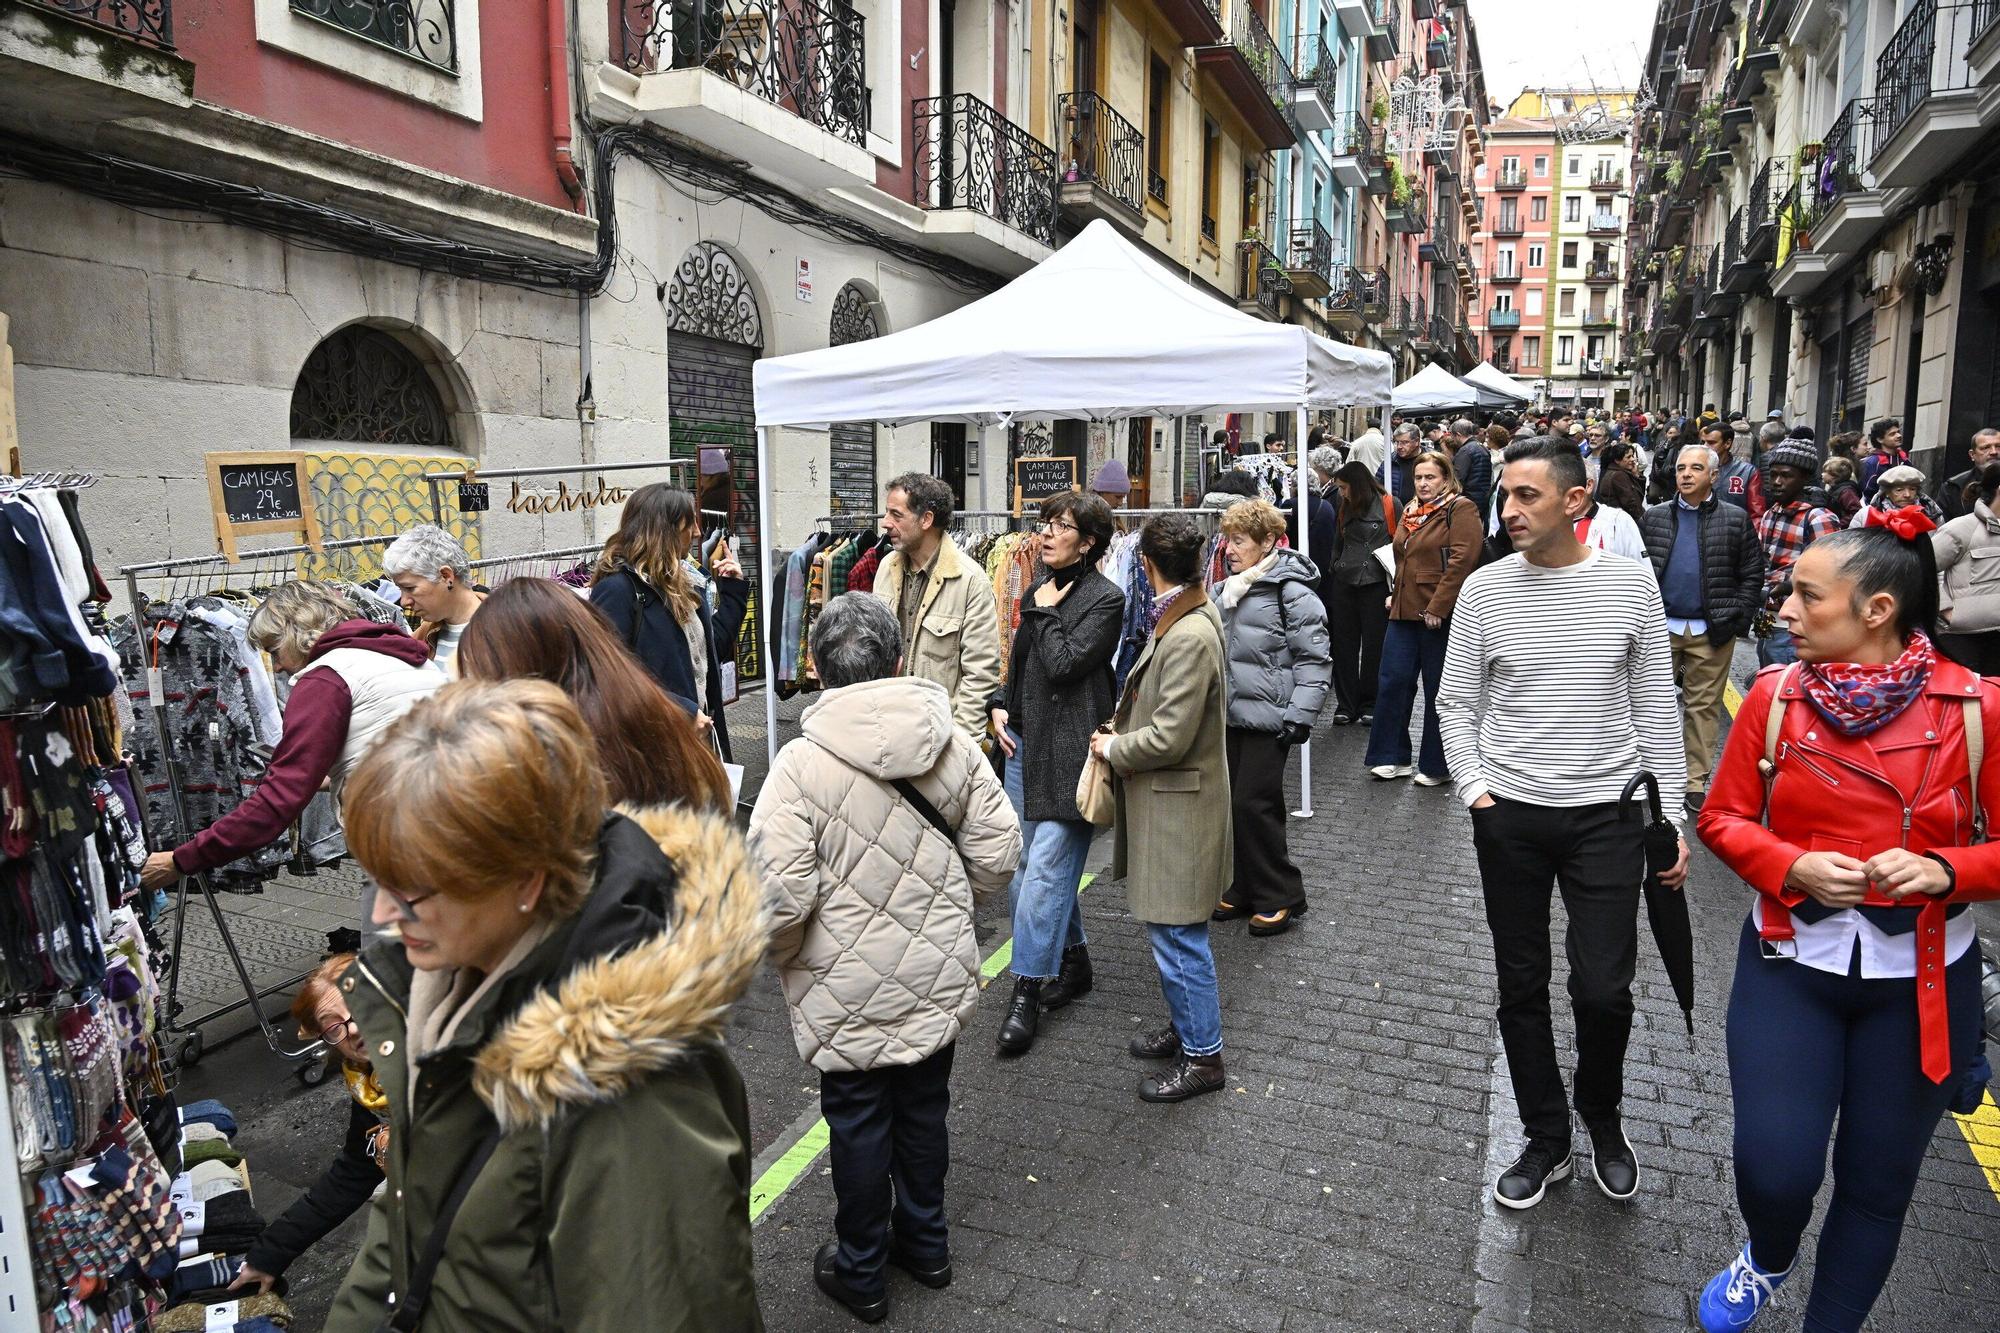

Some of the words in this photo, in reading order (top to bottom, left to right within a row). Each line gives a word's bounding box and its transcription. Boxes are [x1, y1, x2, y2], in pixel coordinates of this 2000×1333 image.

[1026, 462, 1066, 471] CAMISAS
[224, 470, 293, 488] CAMISAS
[1728, 475, 1744, 494] R
[459, 484, 488, 496] JERSEYS
[1027, 481, 1073, 492] JAPONESAS
